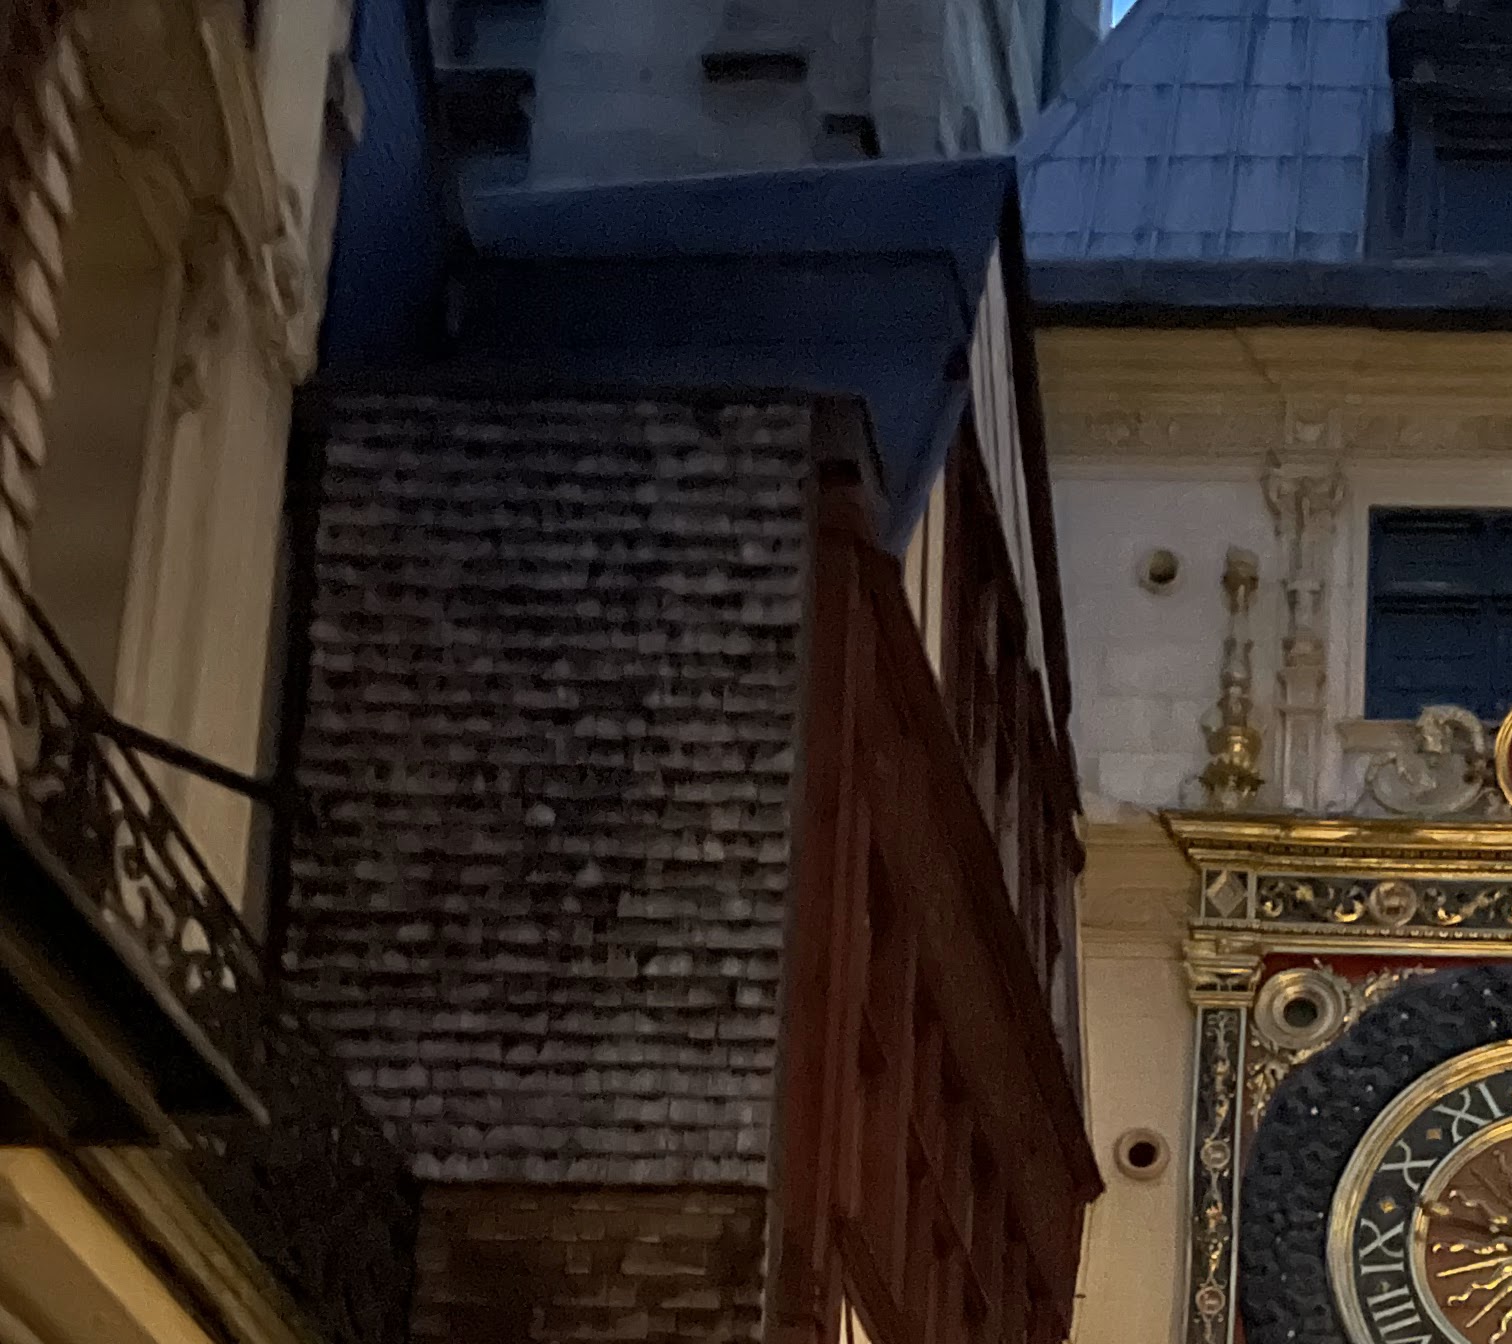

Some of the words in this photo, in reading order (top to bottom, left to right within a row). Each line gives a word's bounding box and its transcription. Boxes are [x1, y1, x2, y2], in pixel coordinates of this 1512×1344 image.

[1433, 1081, 1505, 1143] XI
[1378, 1139, 1438, 1192] X
[1359, 1218, 1404, 1276] IX
